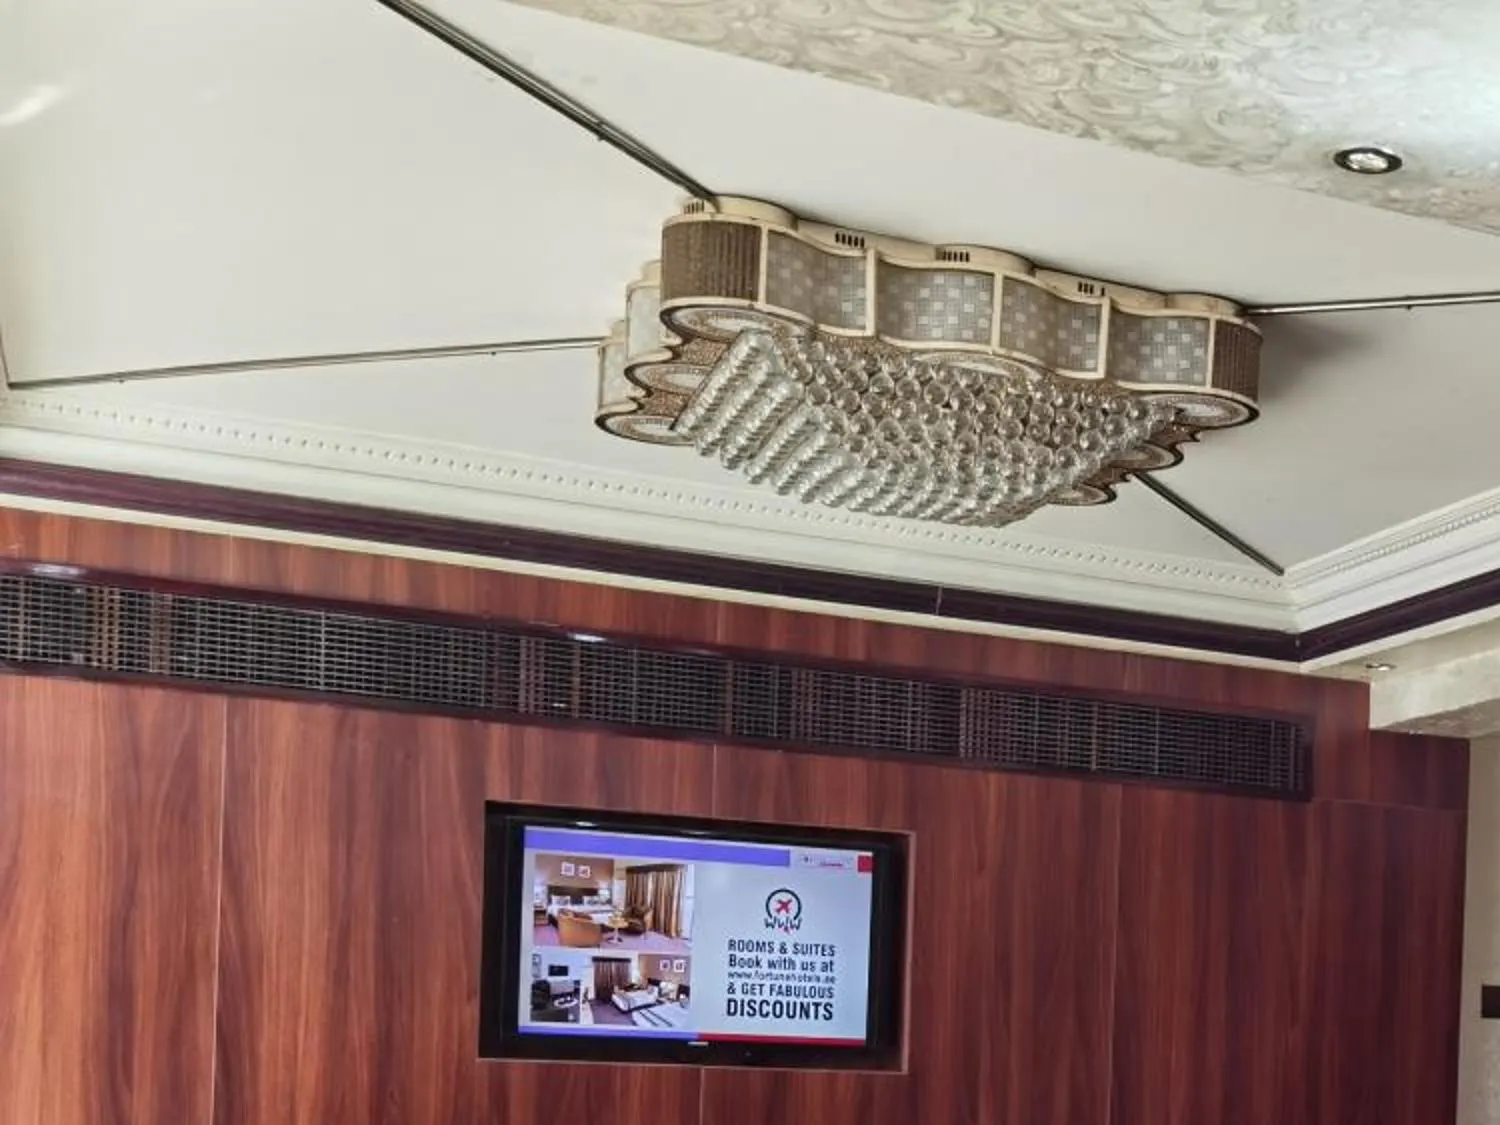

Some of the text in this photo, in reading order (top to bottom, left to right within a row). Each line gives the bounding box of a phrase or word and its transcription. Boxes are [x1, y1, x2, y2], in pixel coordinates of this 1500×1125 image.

[728, 938, 836, 957] ROOMS & SUITES
[729, 954, 835, 973] Book with us at
[727, 982, 835, 999] & GET FABULOUS
[726, 998, 834, 1021] DISCOUNTS
